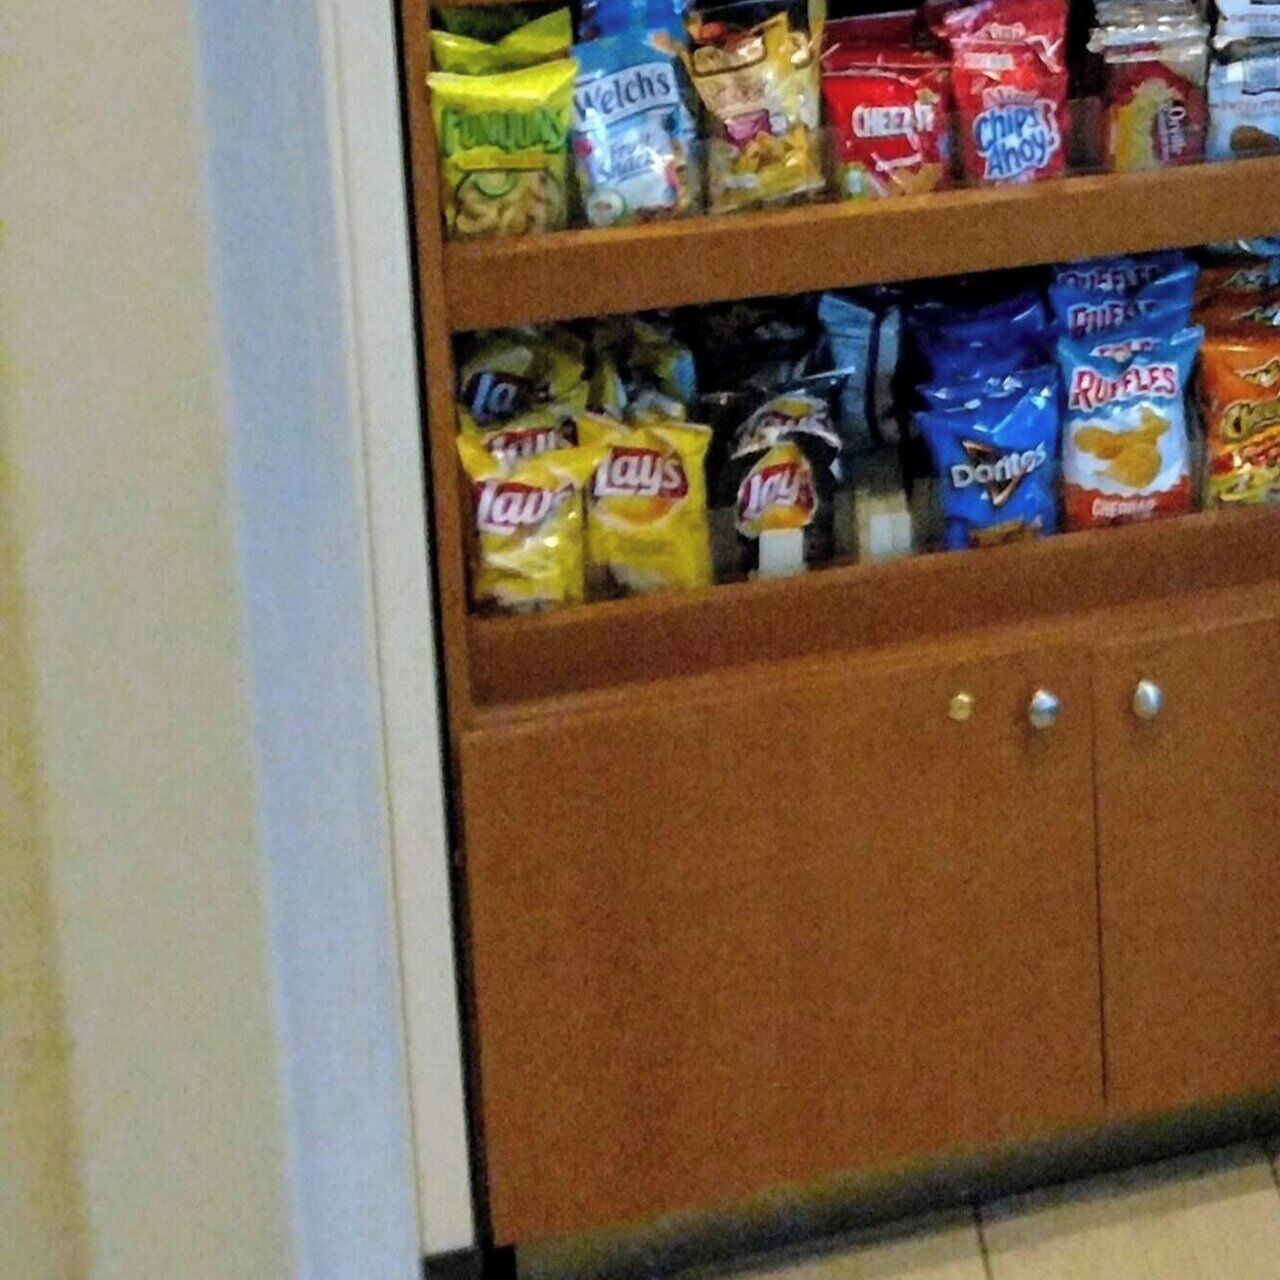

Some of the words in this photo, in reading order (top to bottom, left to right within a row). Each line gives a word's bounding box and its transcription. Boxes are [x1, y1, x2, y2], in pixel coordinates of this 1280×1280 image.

[573, 70, 672, 122] Welch's
[974, 107, 1040, 152] Chips
[1068, 363, 1178, 411] RUFFLES
[951, 440, 1047, 489] Doritos
